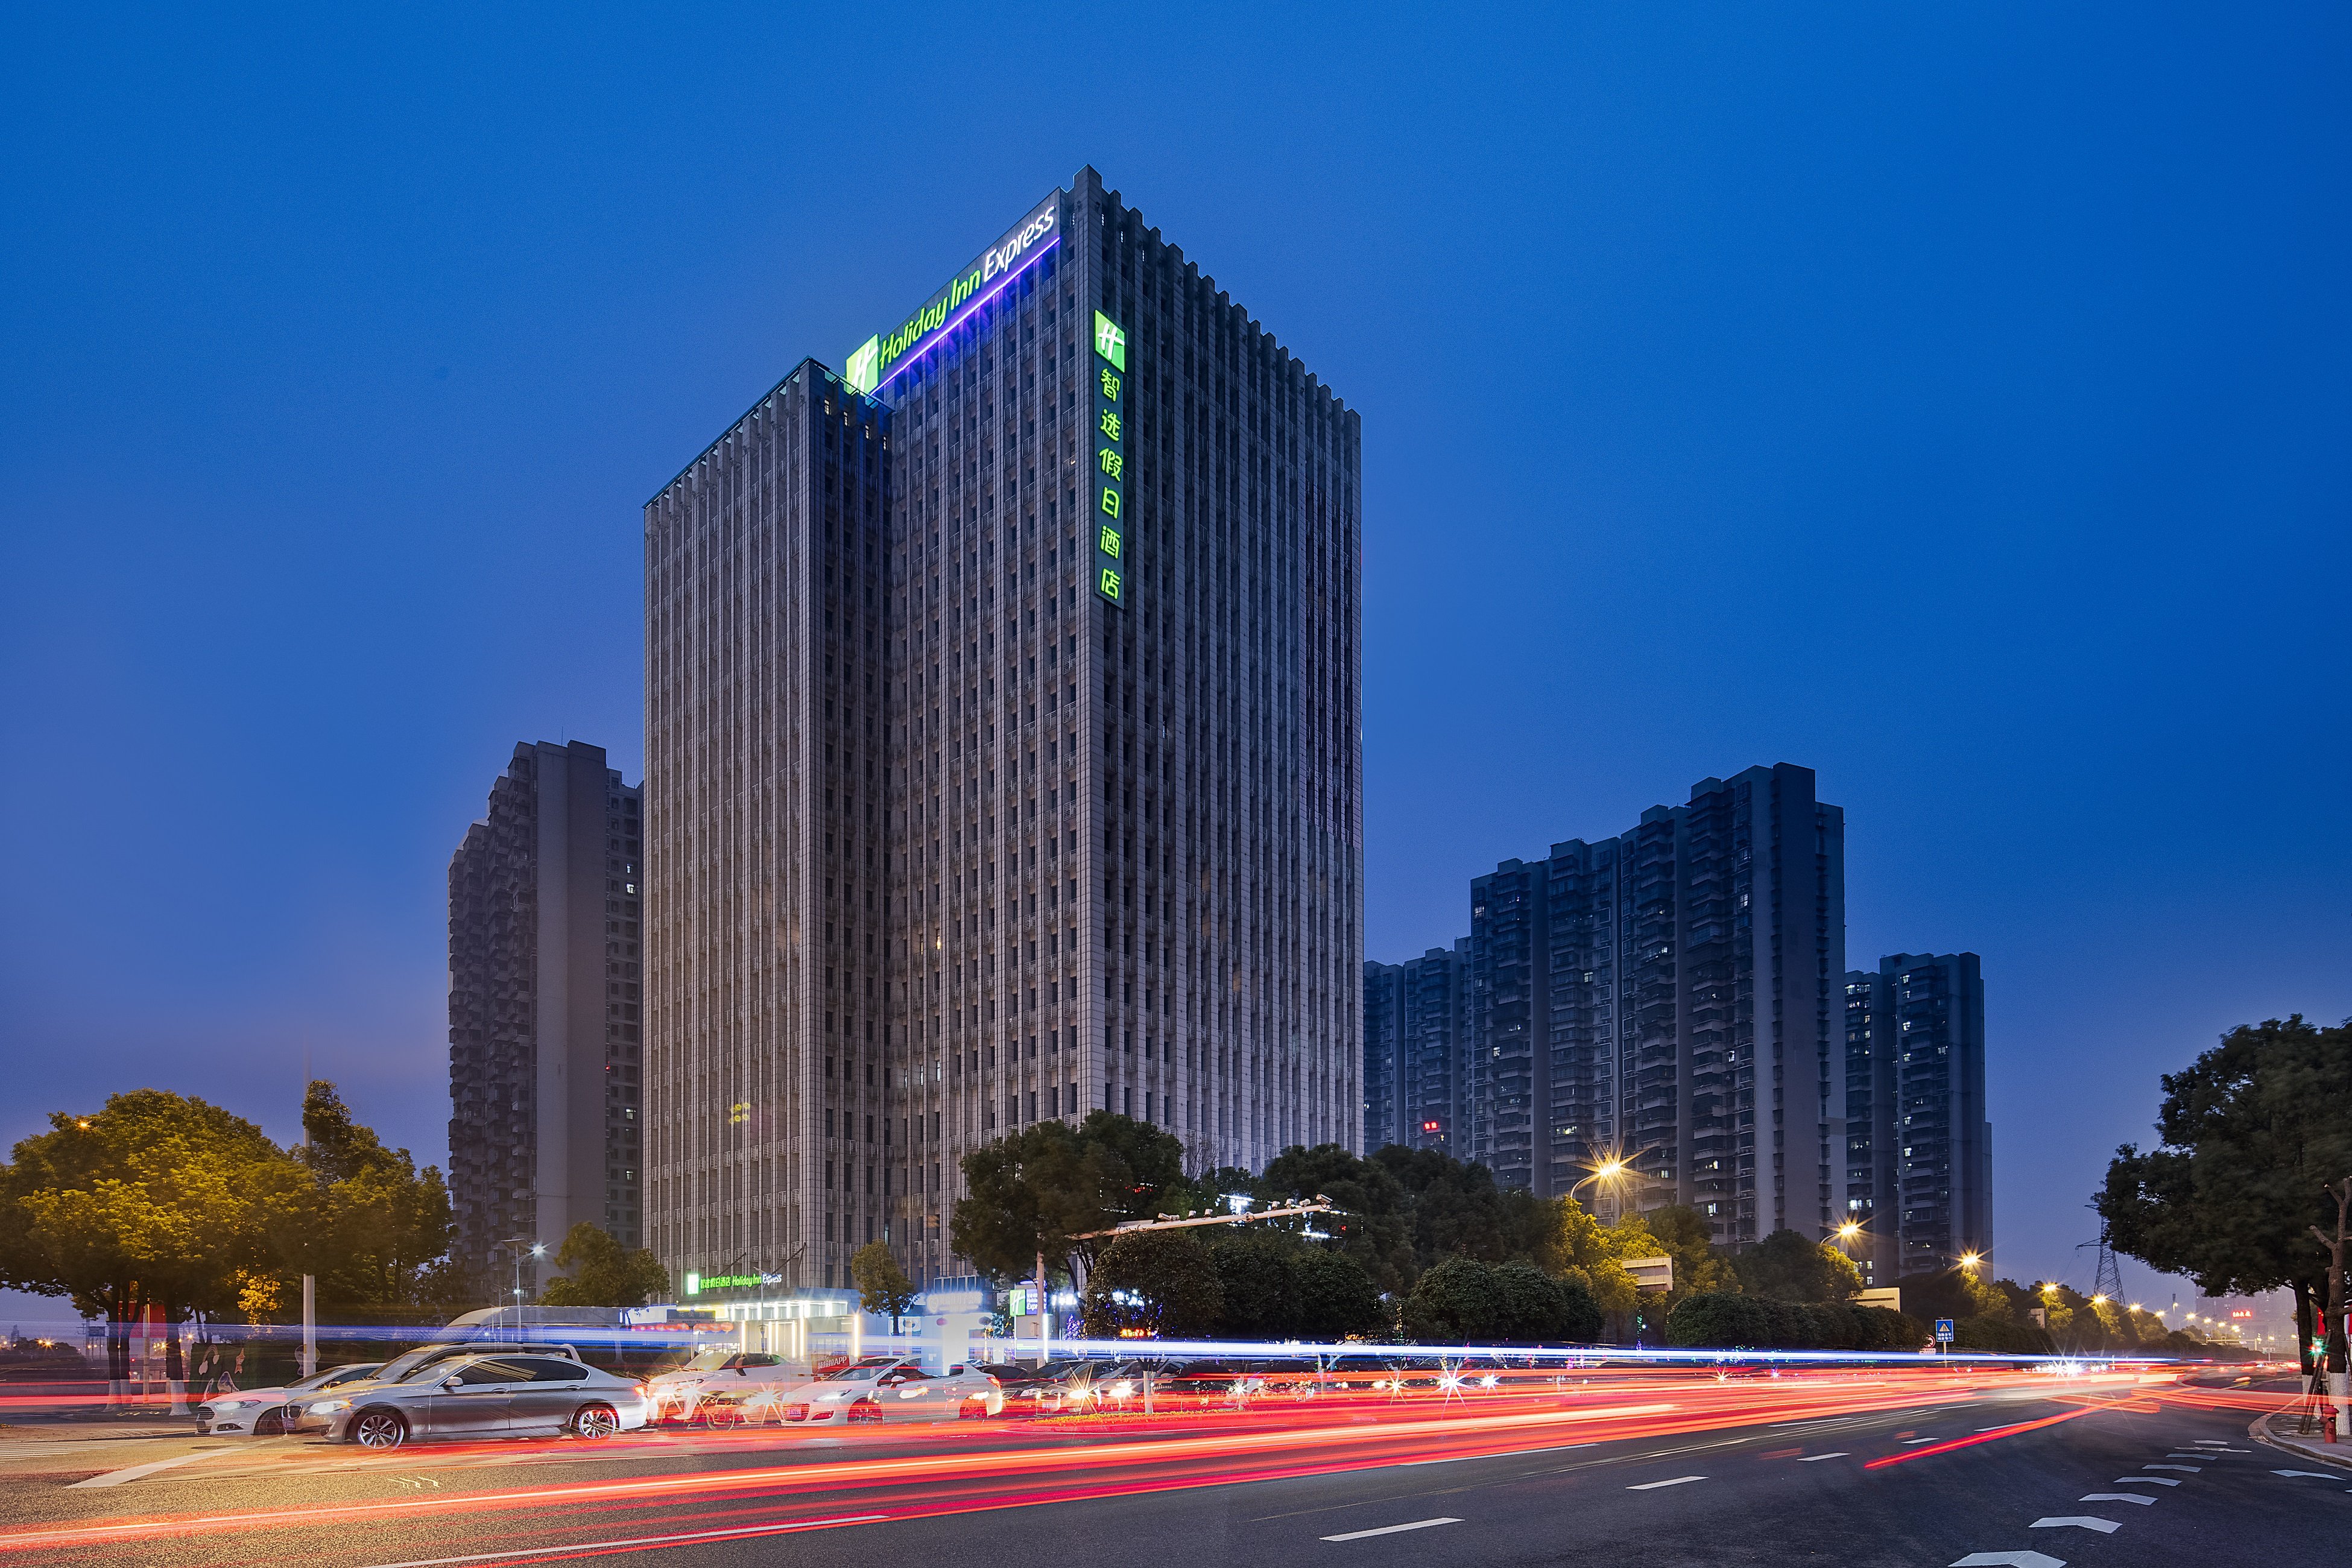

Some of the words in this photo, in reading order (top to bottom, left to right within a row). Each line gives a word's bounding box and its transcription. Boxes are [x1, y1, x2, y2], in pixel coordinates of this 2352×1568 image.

[880, 297, 948, 370] Holiday
[950, 270, 981, 310] Inn
[984, 206, 1055, 282] Express
[1099, 368, 1122, 600] 智选假日酒店
[700, 1276, 731, 1289] 智选假日酒店
[732, 1274, 753, 1287] Holiday
[753, 1273, 762, 1284] Inn
[762, 1273, 782, 1285] Express
